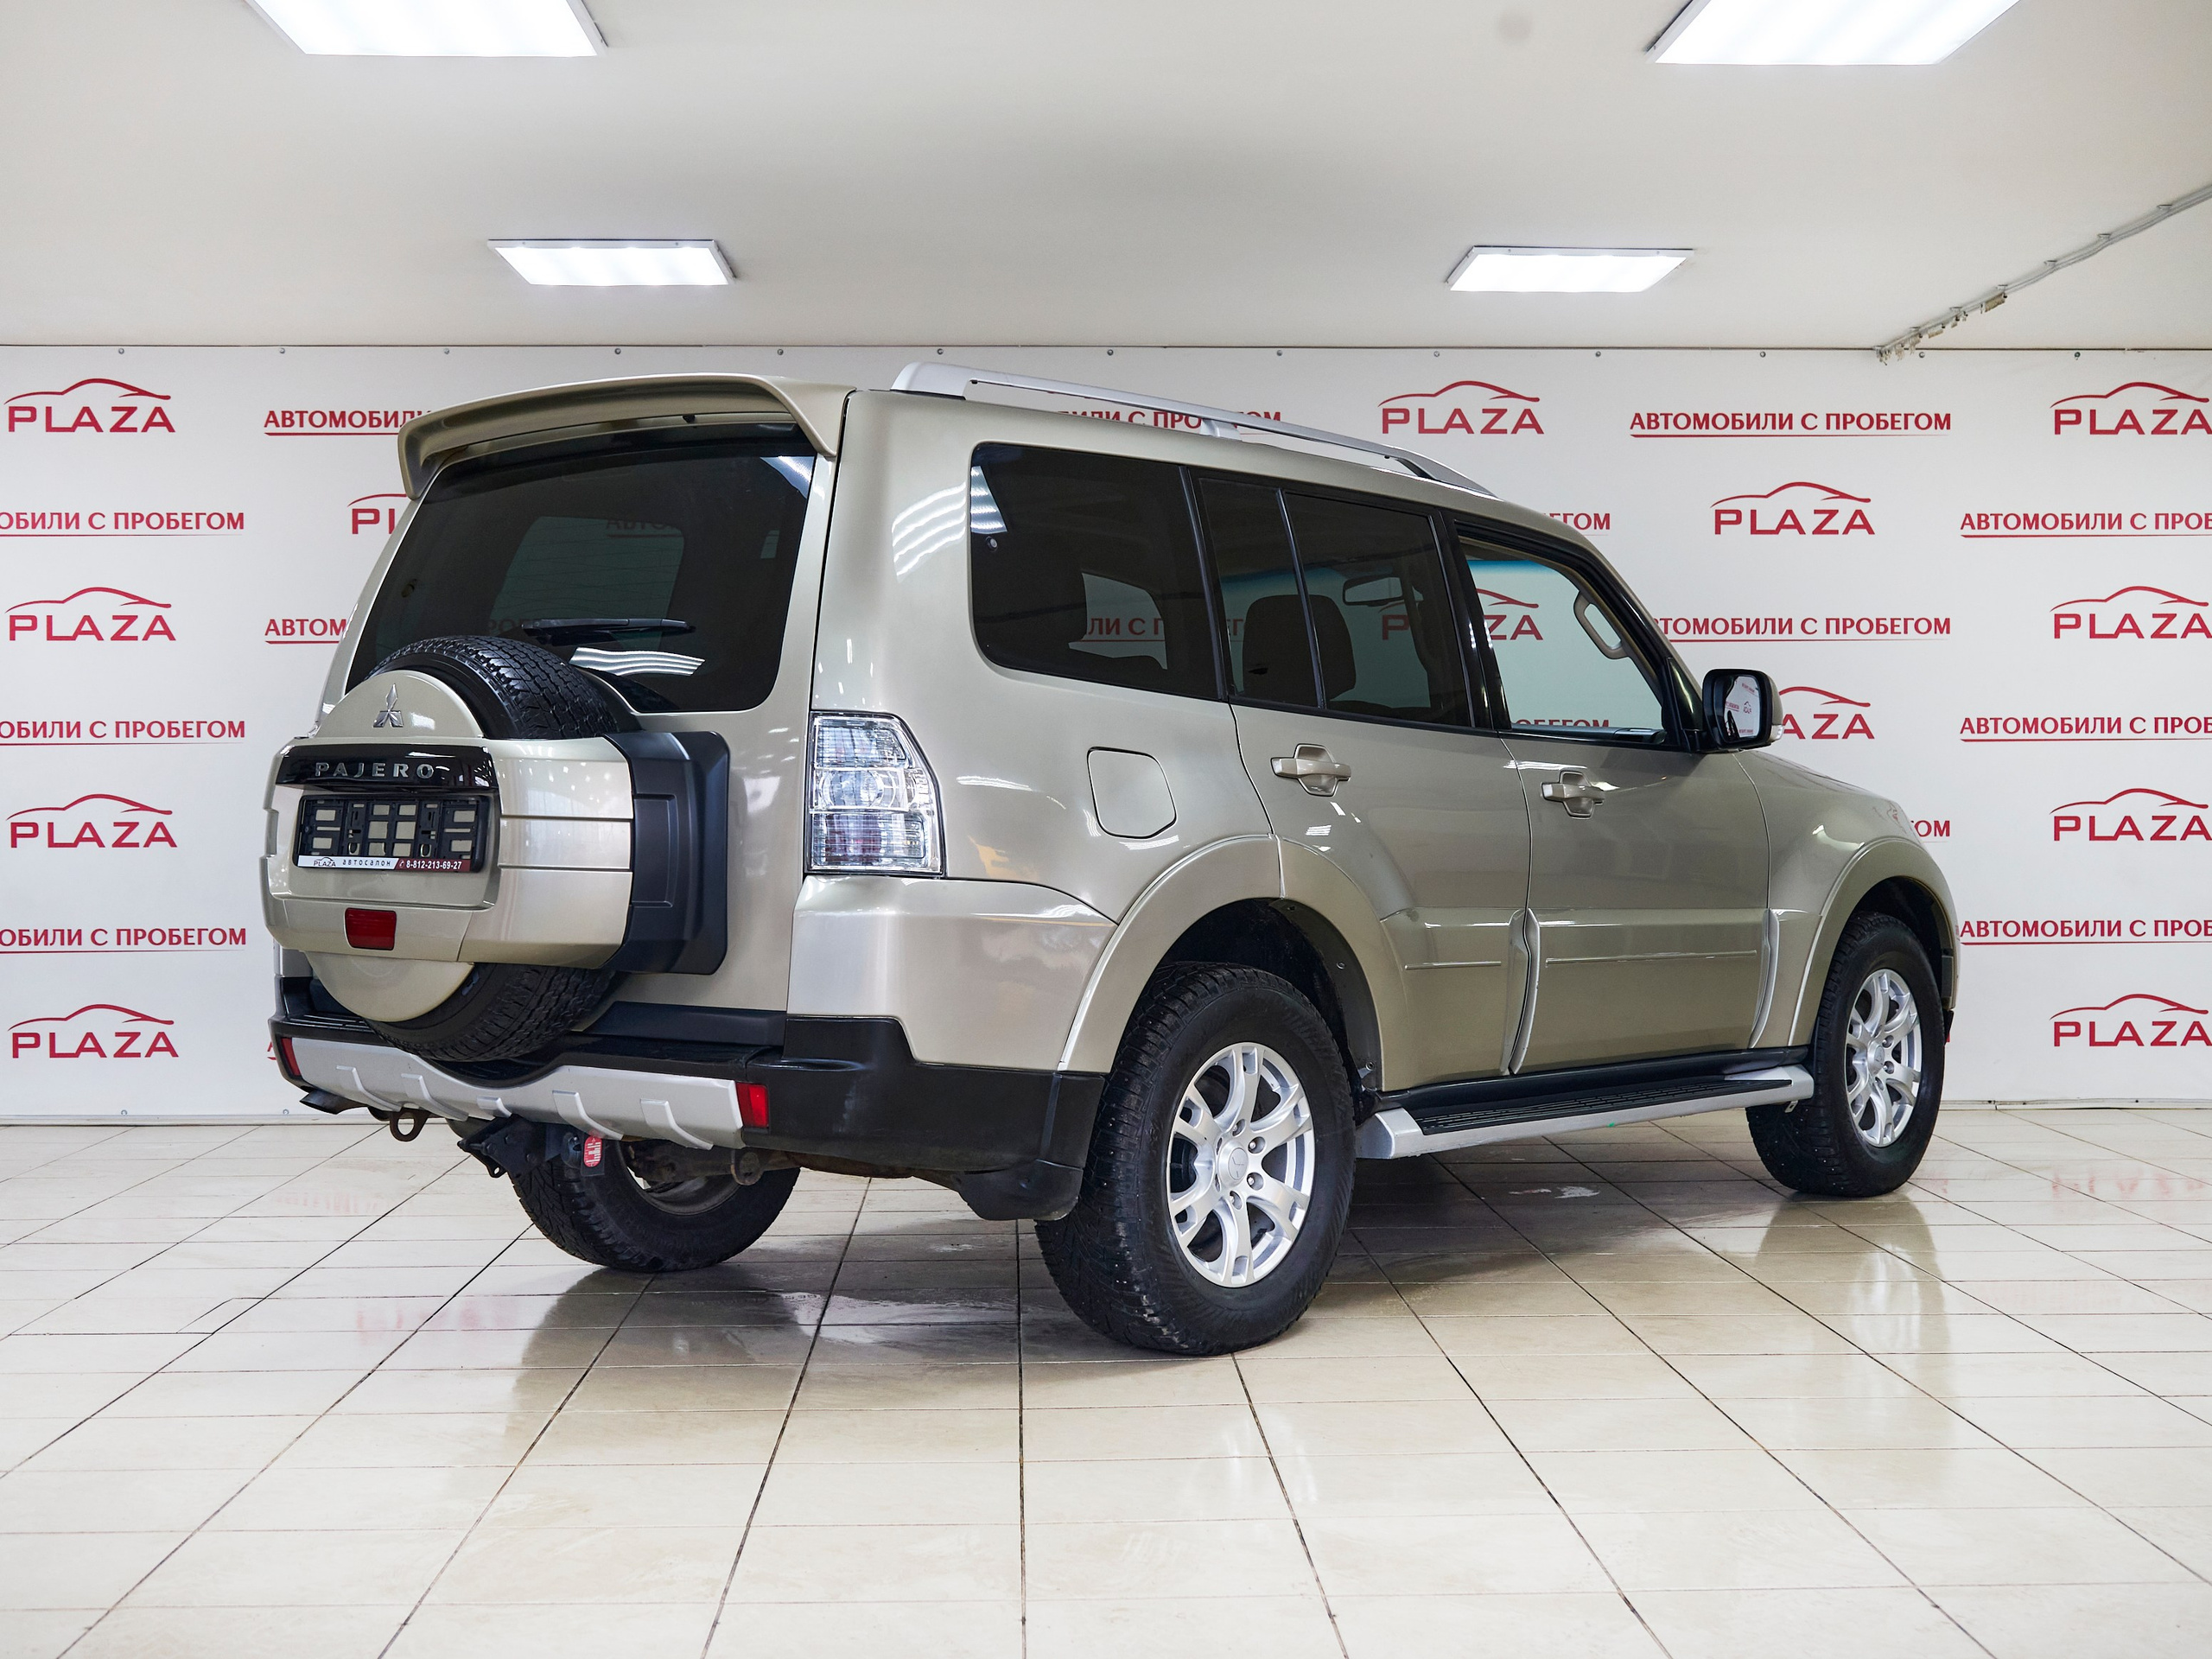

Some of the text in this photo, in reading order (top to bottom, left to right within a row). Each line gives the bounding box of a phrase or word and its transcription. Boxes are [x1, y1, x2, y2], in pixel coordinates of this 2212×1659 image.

[8, 405, 175, 433] PLAZA
[264, 410, 432, 429] АВТОМОБИЛ
[1382, 408, 1544, 435] PLAZA
[1630, 412, 1951, 430] АВТОМОБИЛИ С ПРОБЕГОМ
[2054, 409, 2212, 435] PLAZA
[88, 512, 105, 531] С
[114, 512, 245, 531] ПРОБЕГОМ
[1714, 509, 1875, 535] PLAZA
[1961, 512, 2122, 531] АВТОМОБИЛИ
[2130, 512, 2146, 531] С
[10, 614, 175, 641] PLAZA
[1654, 617, 1951, 635] ТОМОБИЛИ С ПРОБЕГОМ
[2054, 613, 2212, 639] PLAZA
[89, 721, 106, 739] С
[115, 721, 245, 739] ПРОБЕГОМ
[1961, 716, 2122, 734] АВТОМОБИЛИ
[2130, 716, 2146, 734] С
[315, 762, 435, 779] PAJERO
[10, 822, 177, 848] PLAZA
[2054, 815, 2212, 842] PLAZA
[406, 859, 462, 870] 8-812-213-69-27
[91, 928, 107, 946] С
[117, 928, 246, 946] ПРОБЕГОМ
[1961, 920, 2122, 938] АВТОМОБИЛИ
[2130, 919, 2146, 937] С
[2054, 1020, 2212, 1047] PLAZA
[12, 1032, 179, 1058] PLAZA
